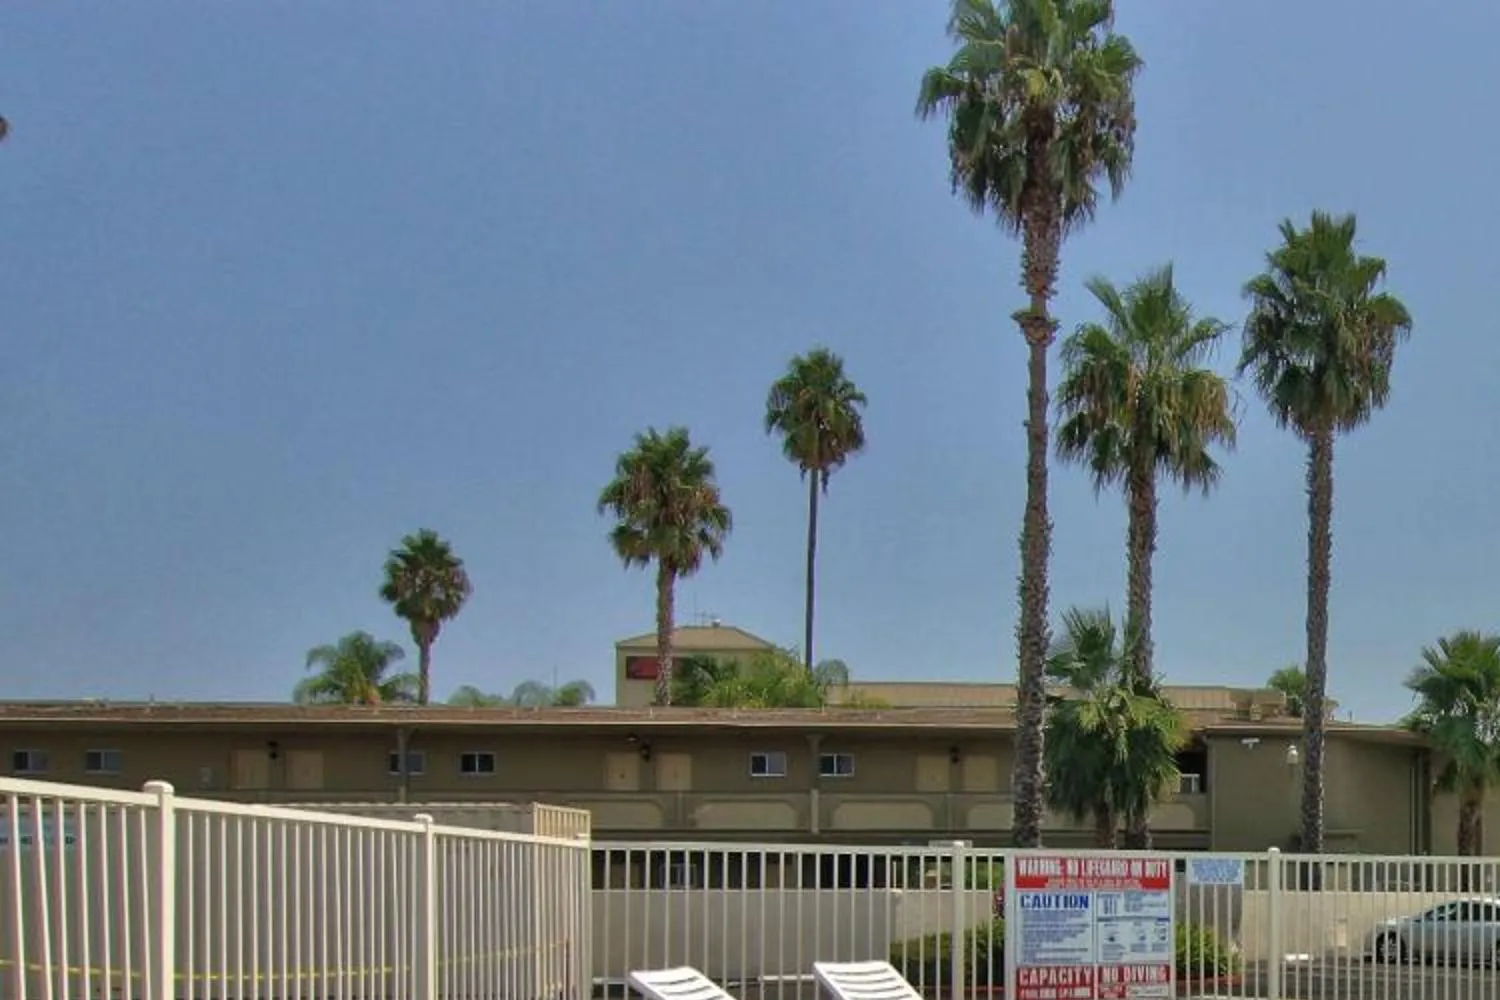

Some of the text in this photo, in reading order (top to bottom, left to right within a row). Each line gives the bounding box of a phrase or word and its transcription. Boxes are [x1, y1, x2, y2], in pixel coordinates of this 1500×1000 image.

[1020, 894, 1089, 909] CAUTION
[1018, 965, 1092, 985] CAPACITY
[1102, 964, 1167, 983] NO DIVING
